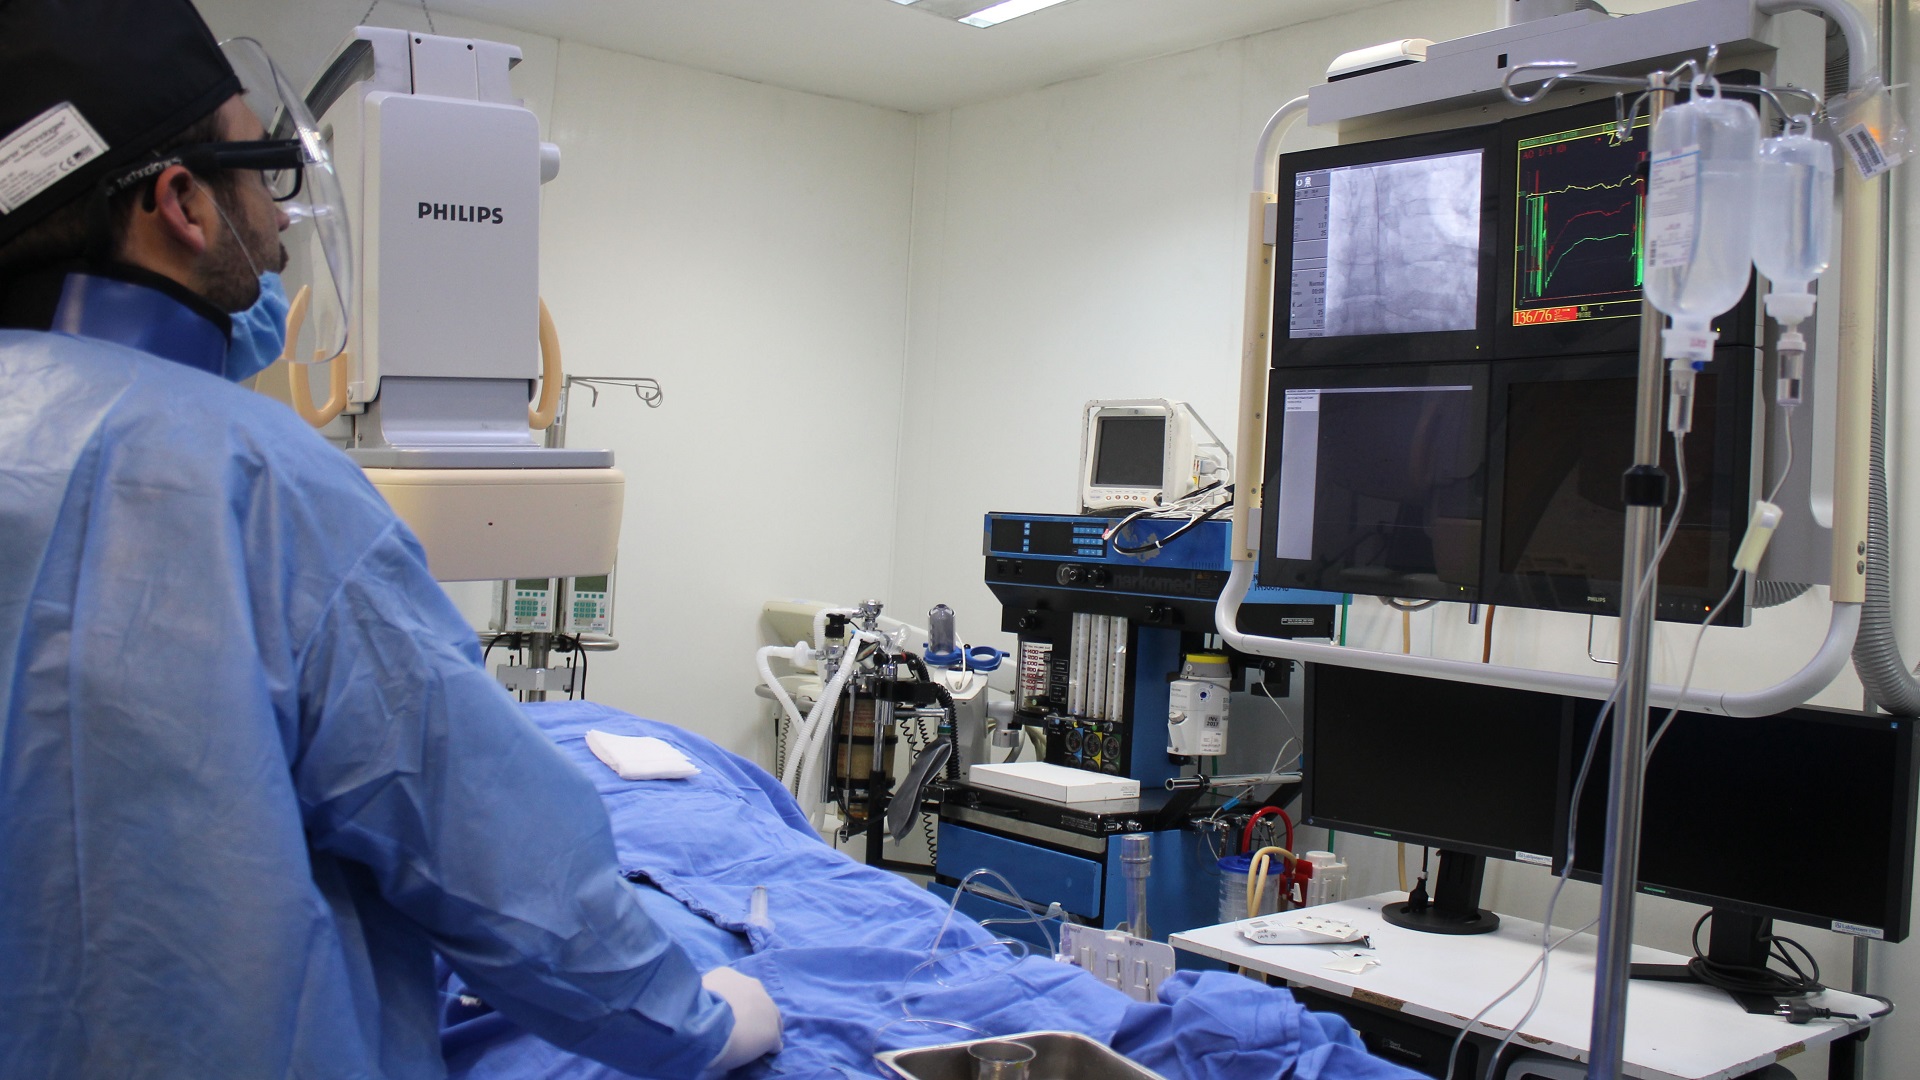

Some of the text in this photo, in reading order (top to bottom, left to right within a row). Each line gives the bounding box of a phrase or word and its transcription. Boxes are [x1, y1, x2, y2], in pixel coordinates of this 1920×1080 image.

[418, 202, 503, 224] PHILIPS
[1515, 309, 1552, 324] 136/76
[1113, 567, 1196, 595] narkomed
